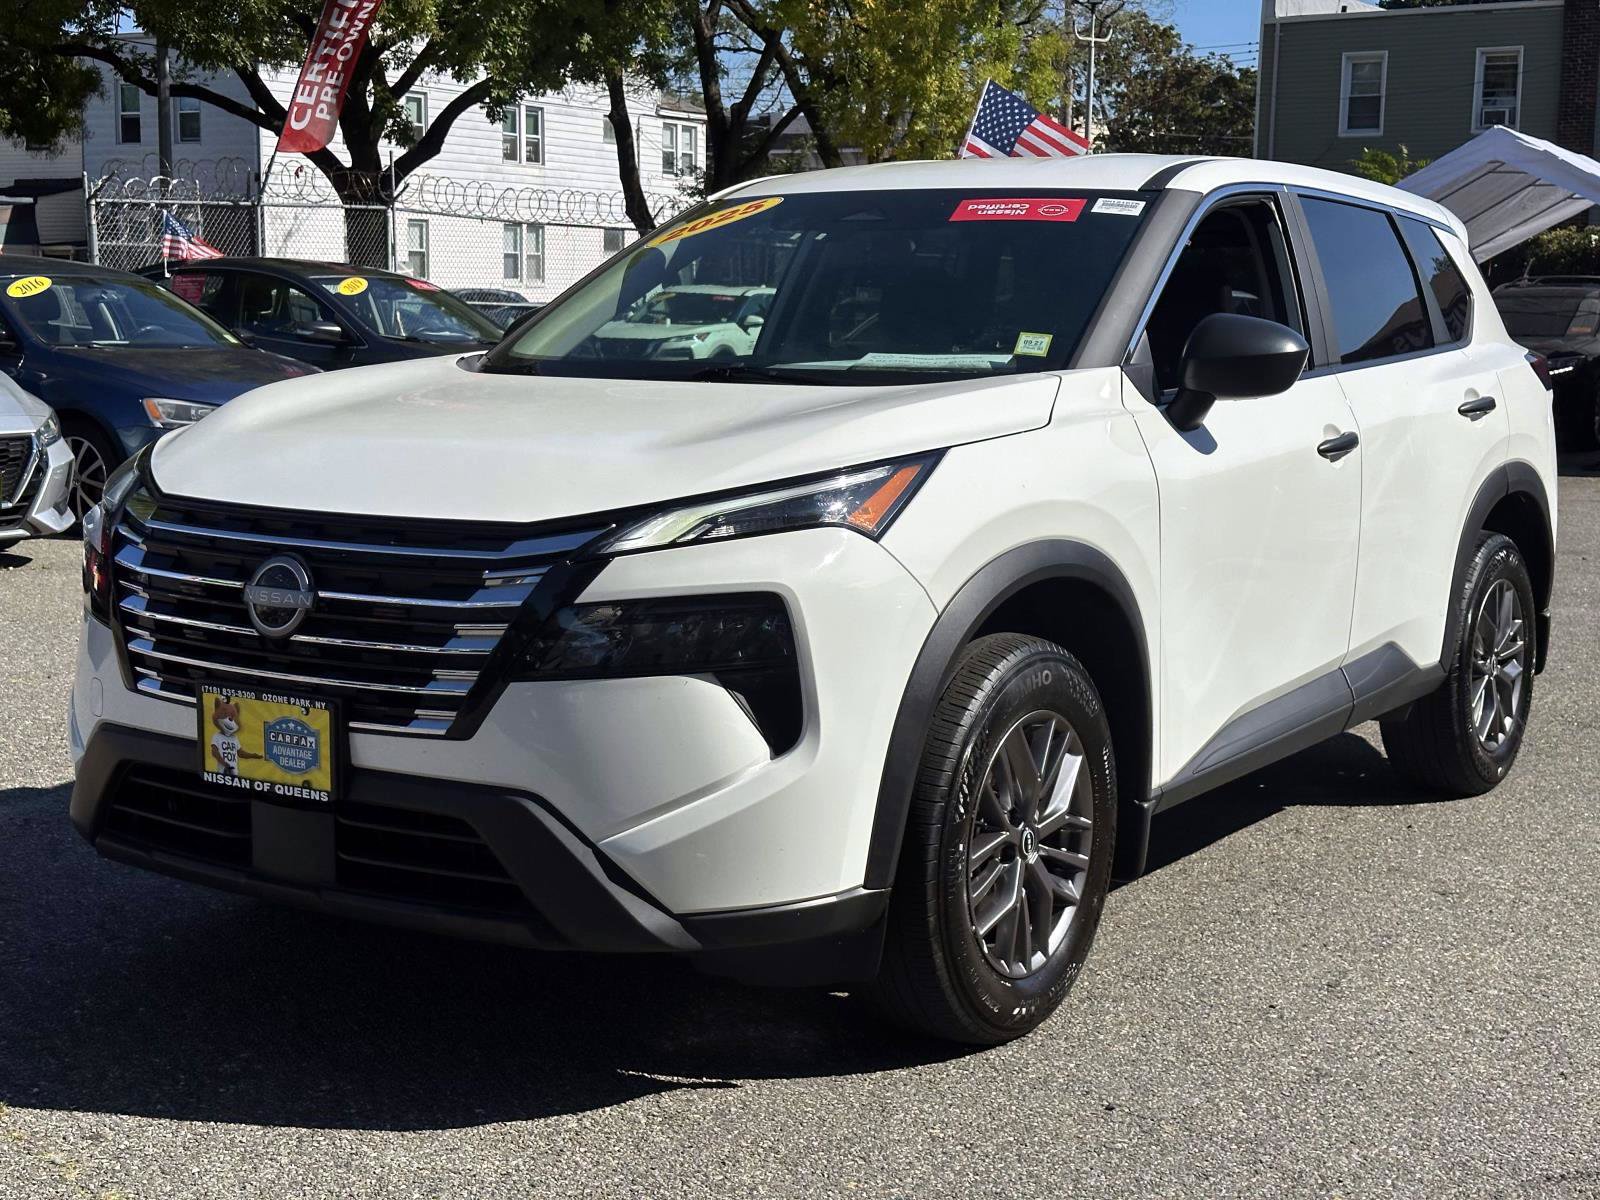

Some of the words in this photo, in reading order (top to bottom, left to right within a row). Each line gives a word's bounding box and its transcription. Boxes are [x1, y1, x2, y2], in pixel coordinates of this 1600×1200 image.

[967, 203, 1030, 211] Certified
[659, 200, 769, 244] 2025
[15, 278, 45, 295] 2016
[246, 588, 312, 606] NISSAN
[201, 685, 220, 695] (718)
[222, 688, 256, 700] 835-8300
[262, 693, 288, 704] OZONE
[315, 700, 326, 710] NY
[221, 741, 236, 751] CAR
[269, 732, 316, 749] CARFAX
[222, 751, 237, 763] FOX
[272, 745, 313, 760] ADVANTAGE
[279, 756, 306, 770] DEALER
[203, 771, 250, 789] NISSAN
[254, 781, 271, 792] OF
[274, 784, 329, 802] QUEENS
